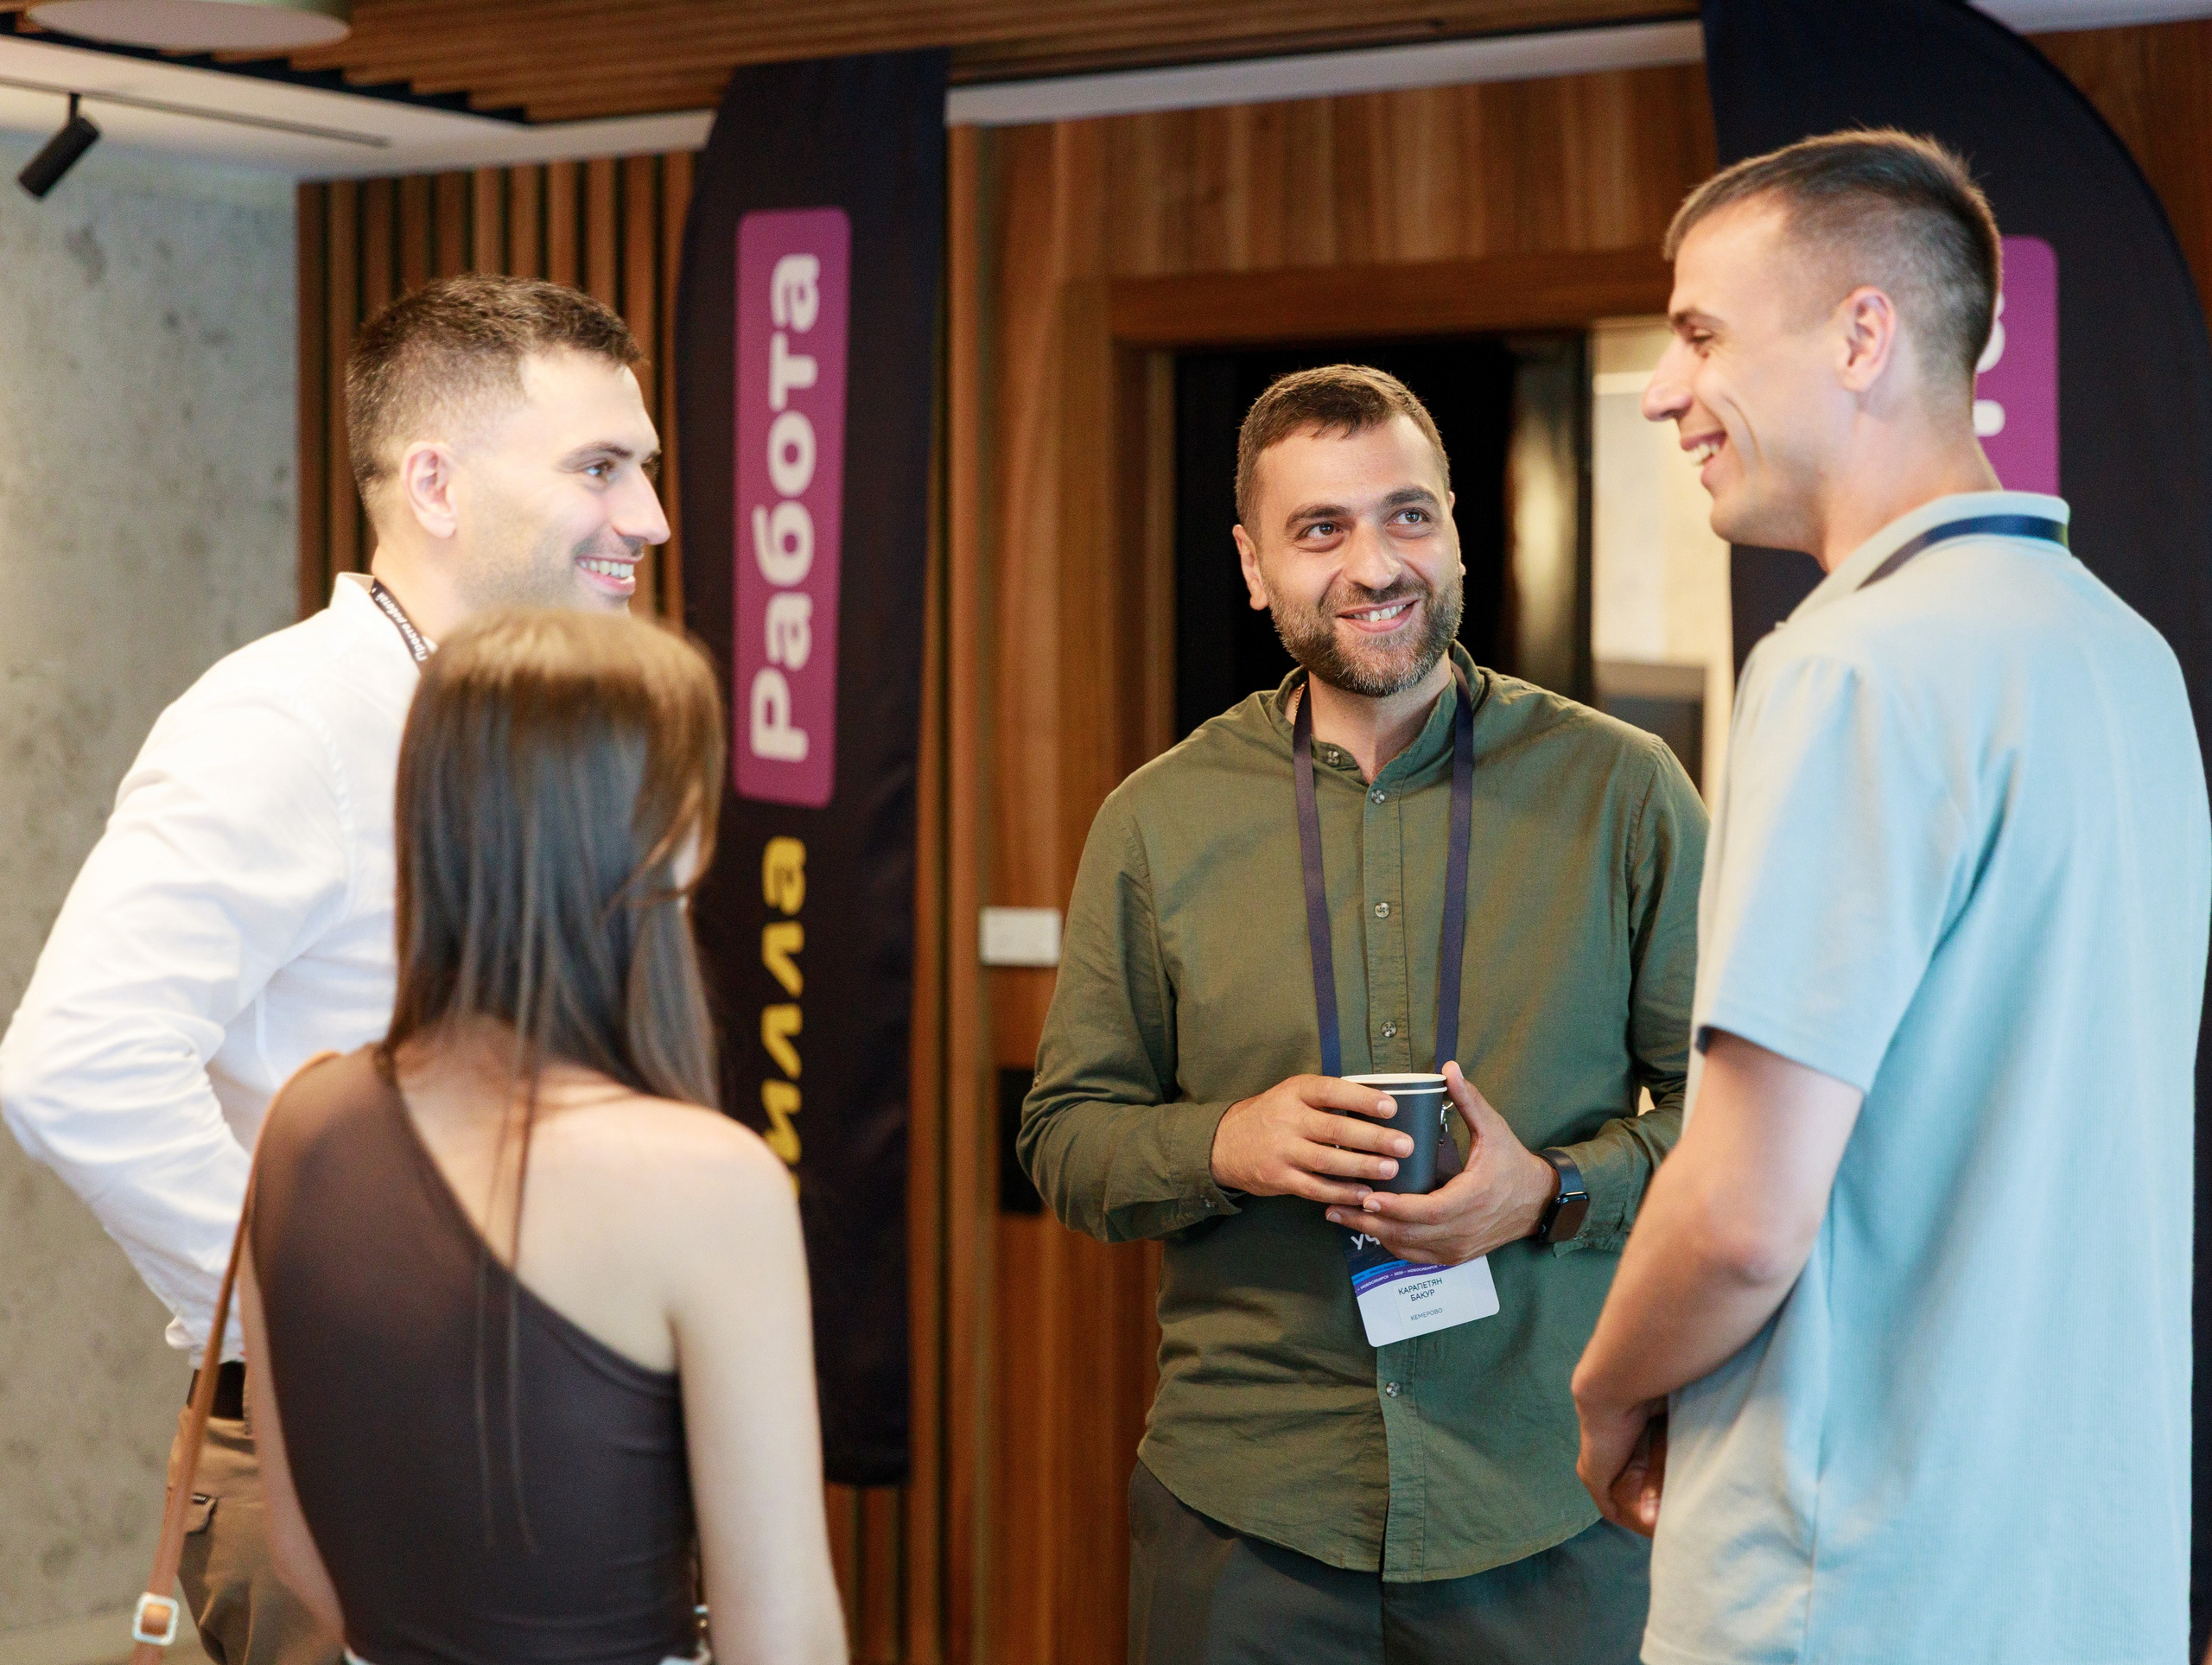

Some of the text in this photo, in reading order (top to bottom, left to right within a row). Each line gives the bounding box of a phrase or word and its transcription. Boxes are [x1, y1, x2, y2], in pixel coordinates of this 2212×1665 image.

[749, 253, 821, 1199] илла Работа
[1398, 1277, 1443, 1295] КАРАПЕТЯН
[1410, 1288, 1435, 1302] БАКУР
[1410, 1307, 1443, 1321] КЕМЕРОВО
